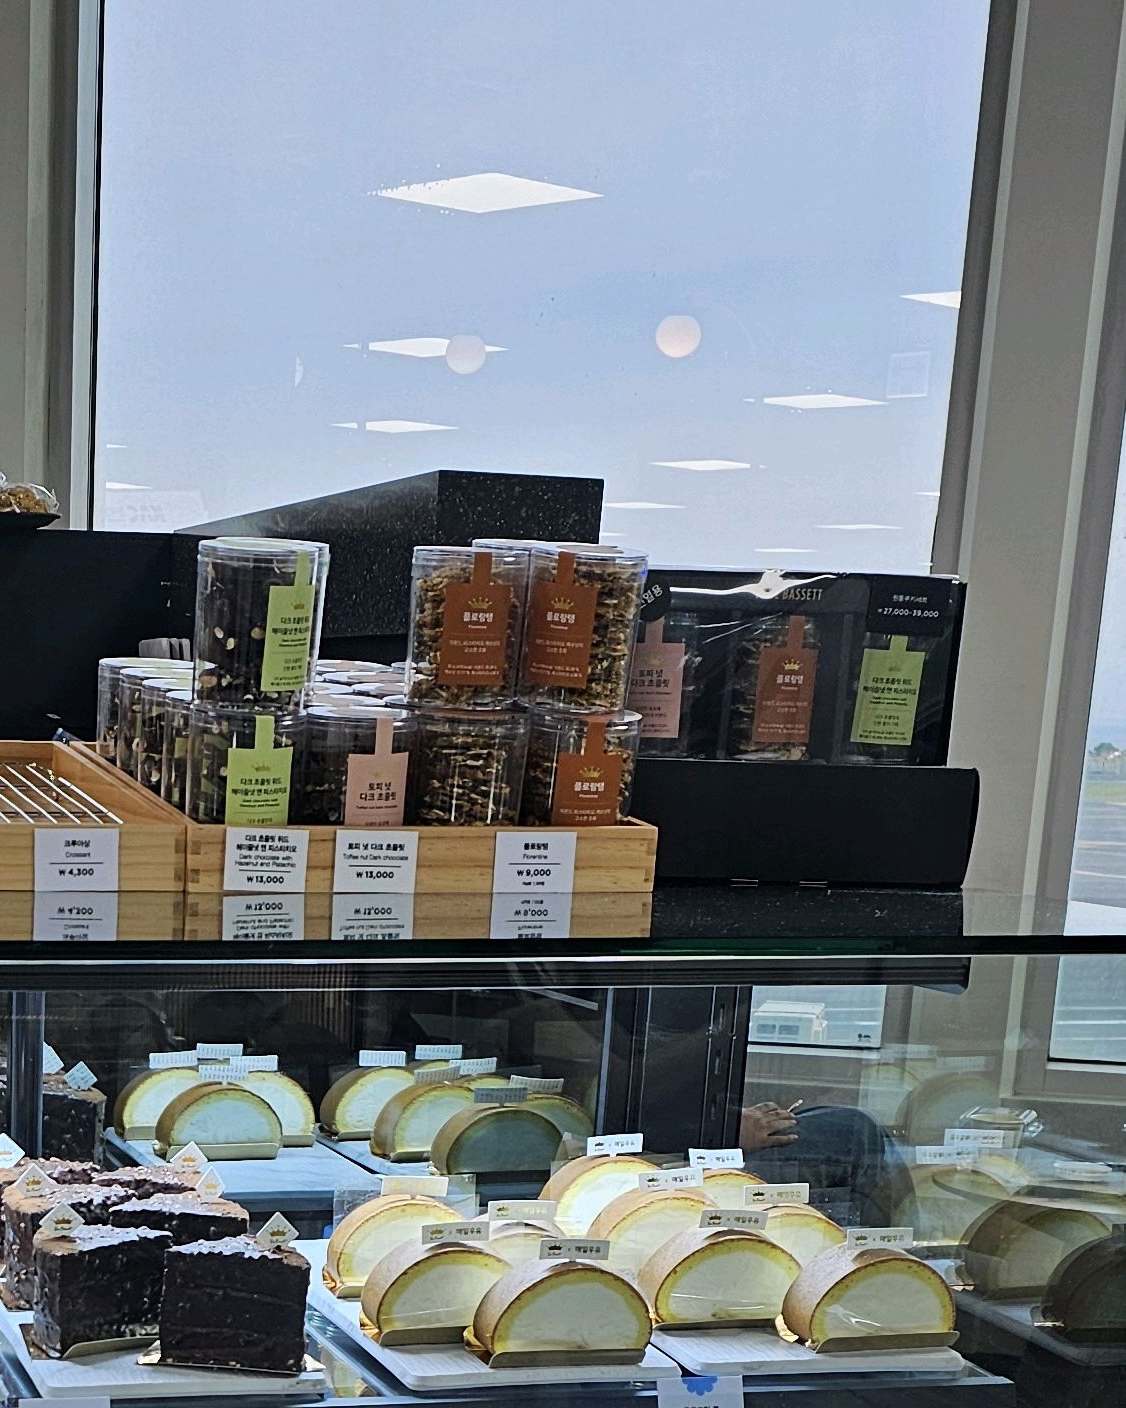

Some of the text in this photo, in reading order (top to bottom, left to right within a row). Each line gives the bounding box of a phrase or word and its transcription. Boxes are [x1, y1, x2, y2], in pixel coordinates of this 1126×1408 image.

[641, 584, 663, 608] 열용
[783, 588, 823, 600] BASSETT
[360, 793, 375, 801] 다크
[365, 871, 394, 879] 13,000
[526, 869, 551, 878] 9,000
[255, 876, 285, 884] 13,000
